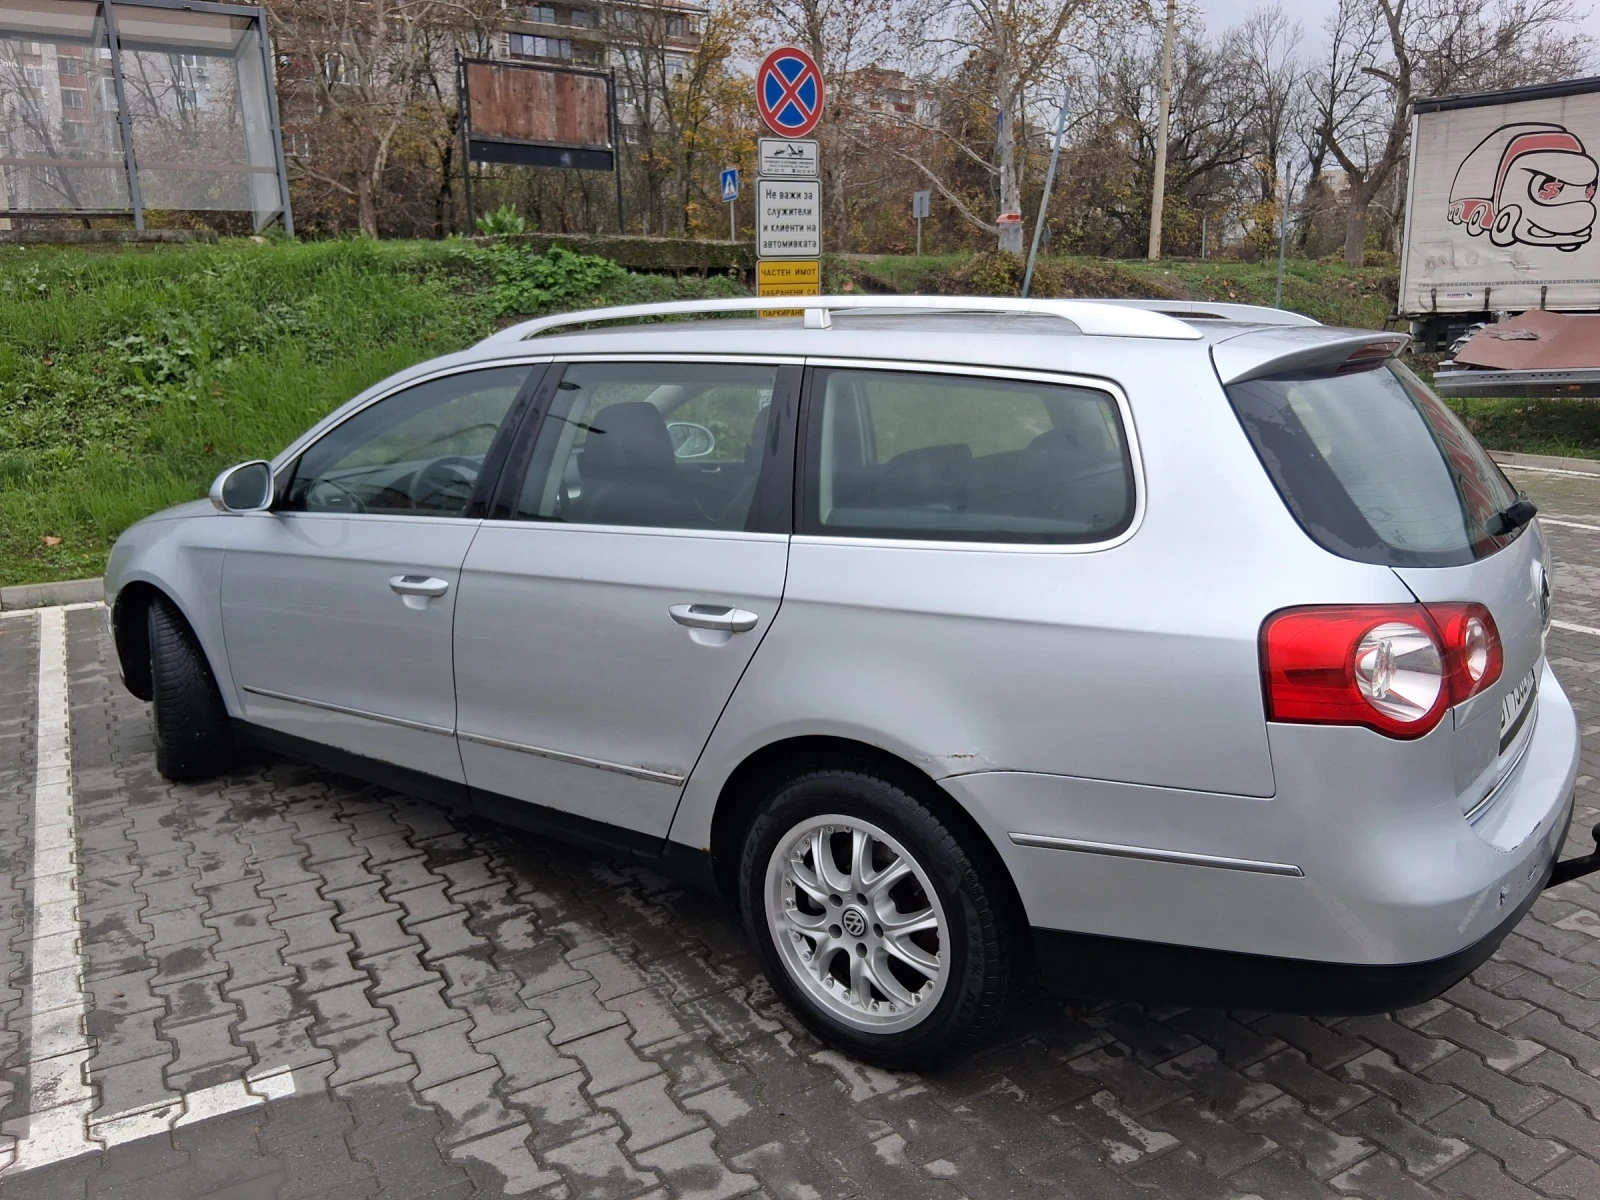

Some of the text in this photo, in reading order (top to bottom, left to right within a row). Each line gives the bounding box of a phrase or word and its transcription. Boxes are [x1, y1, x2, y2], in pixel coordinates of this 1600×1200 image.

[765, 189, 813, 200] Не важи за
[766, 207, 812, 218] служители
[763, 224, 817, 232] и клиенти на
[762, 240, 817, 249] автомивката
[761, 268, 816, 277] ЧАСТЕН ИМОТ
[761, 289, 804, 297] ЗАБРАНЕНИ
